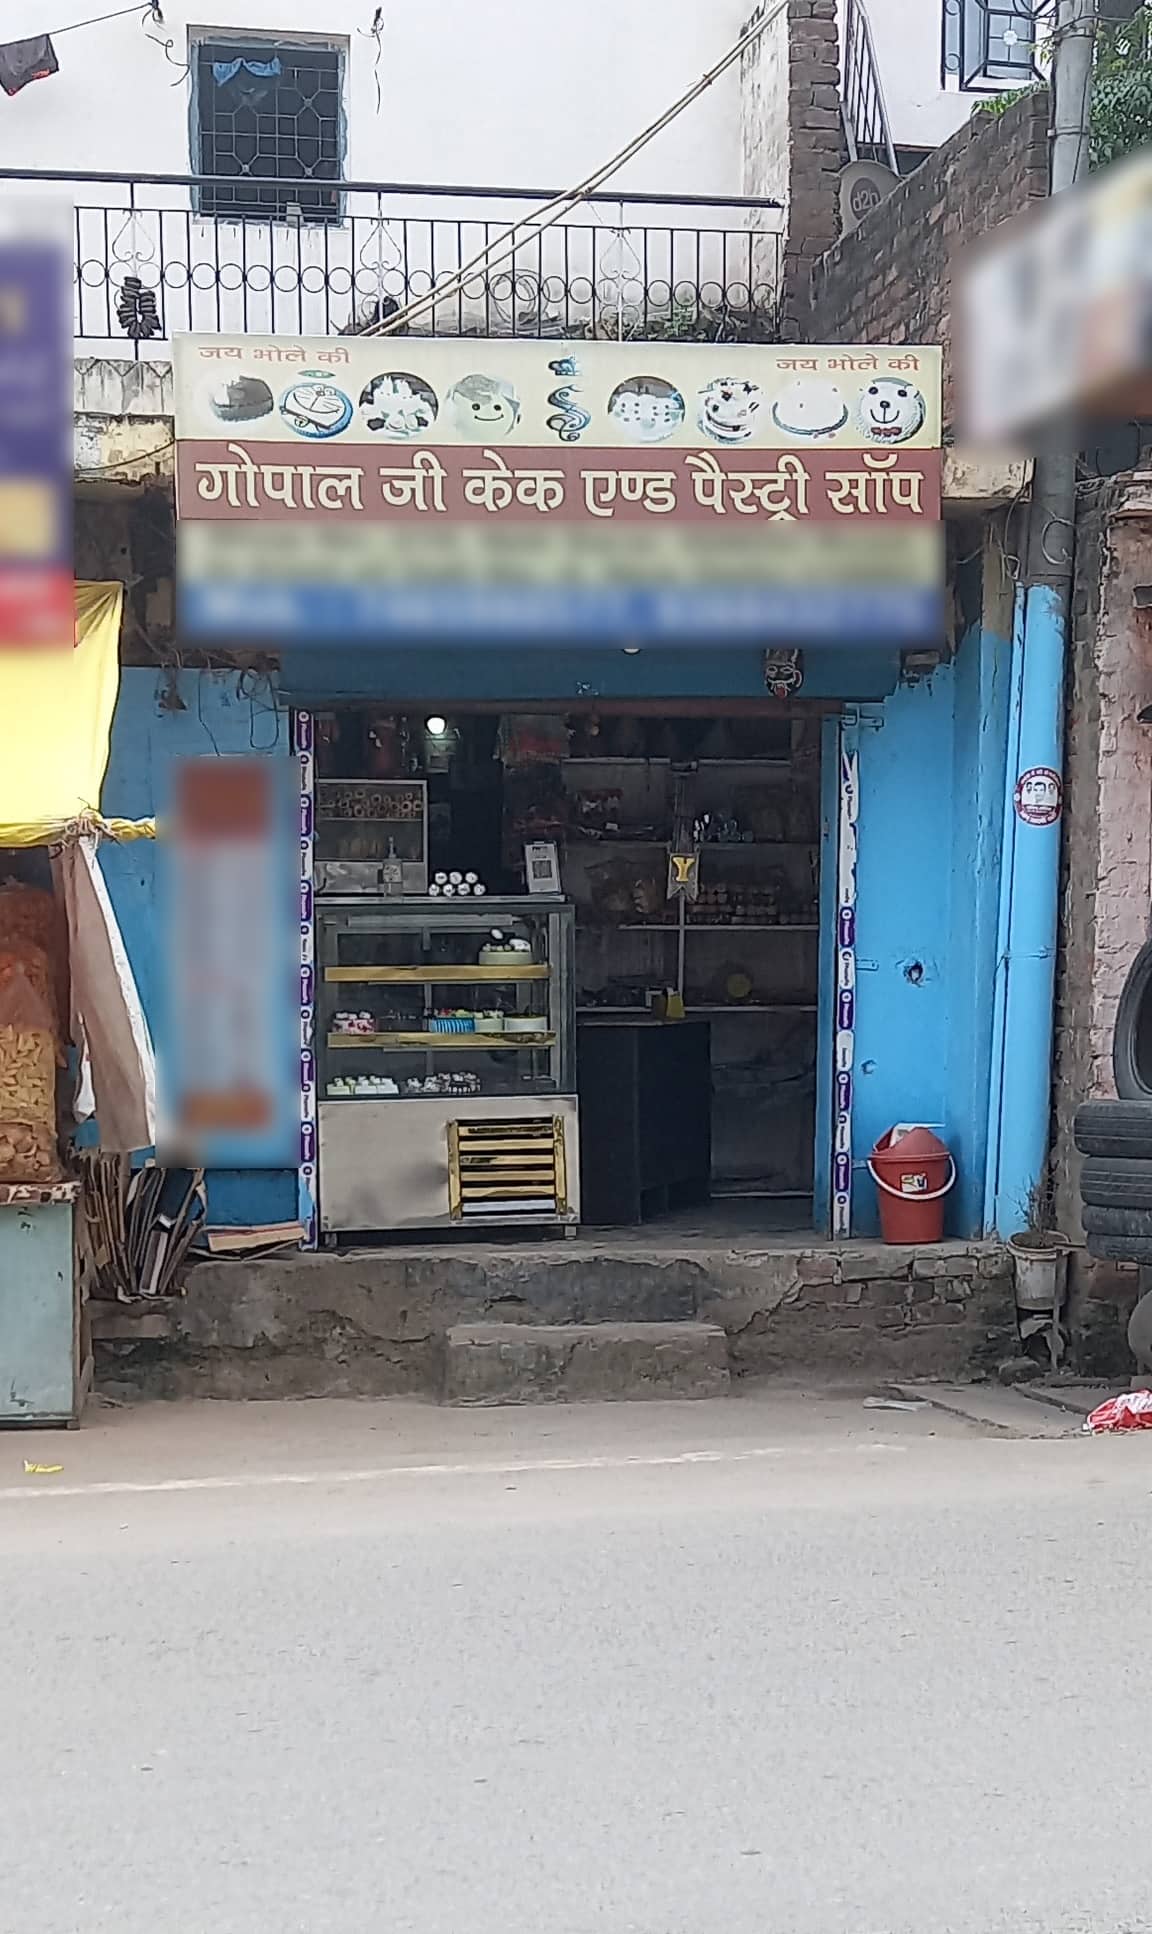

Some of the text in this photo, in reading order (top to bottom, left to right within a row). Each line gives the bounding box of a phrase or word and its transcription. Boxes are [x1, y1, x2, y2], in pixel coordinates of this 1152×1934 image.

[853, 189, 879, 211] d2h
[199, 344, 350, 364] जय भोले की
[776, 353, 920, 371] जय भोले की
[194, 443, 925, 520] गोपाल जी केक एण्ड पैस्ट्री सॉप
